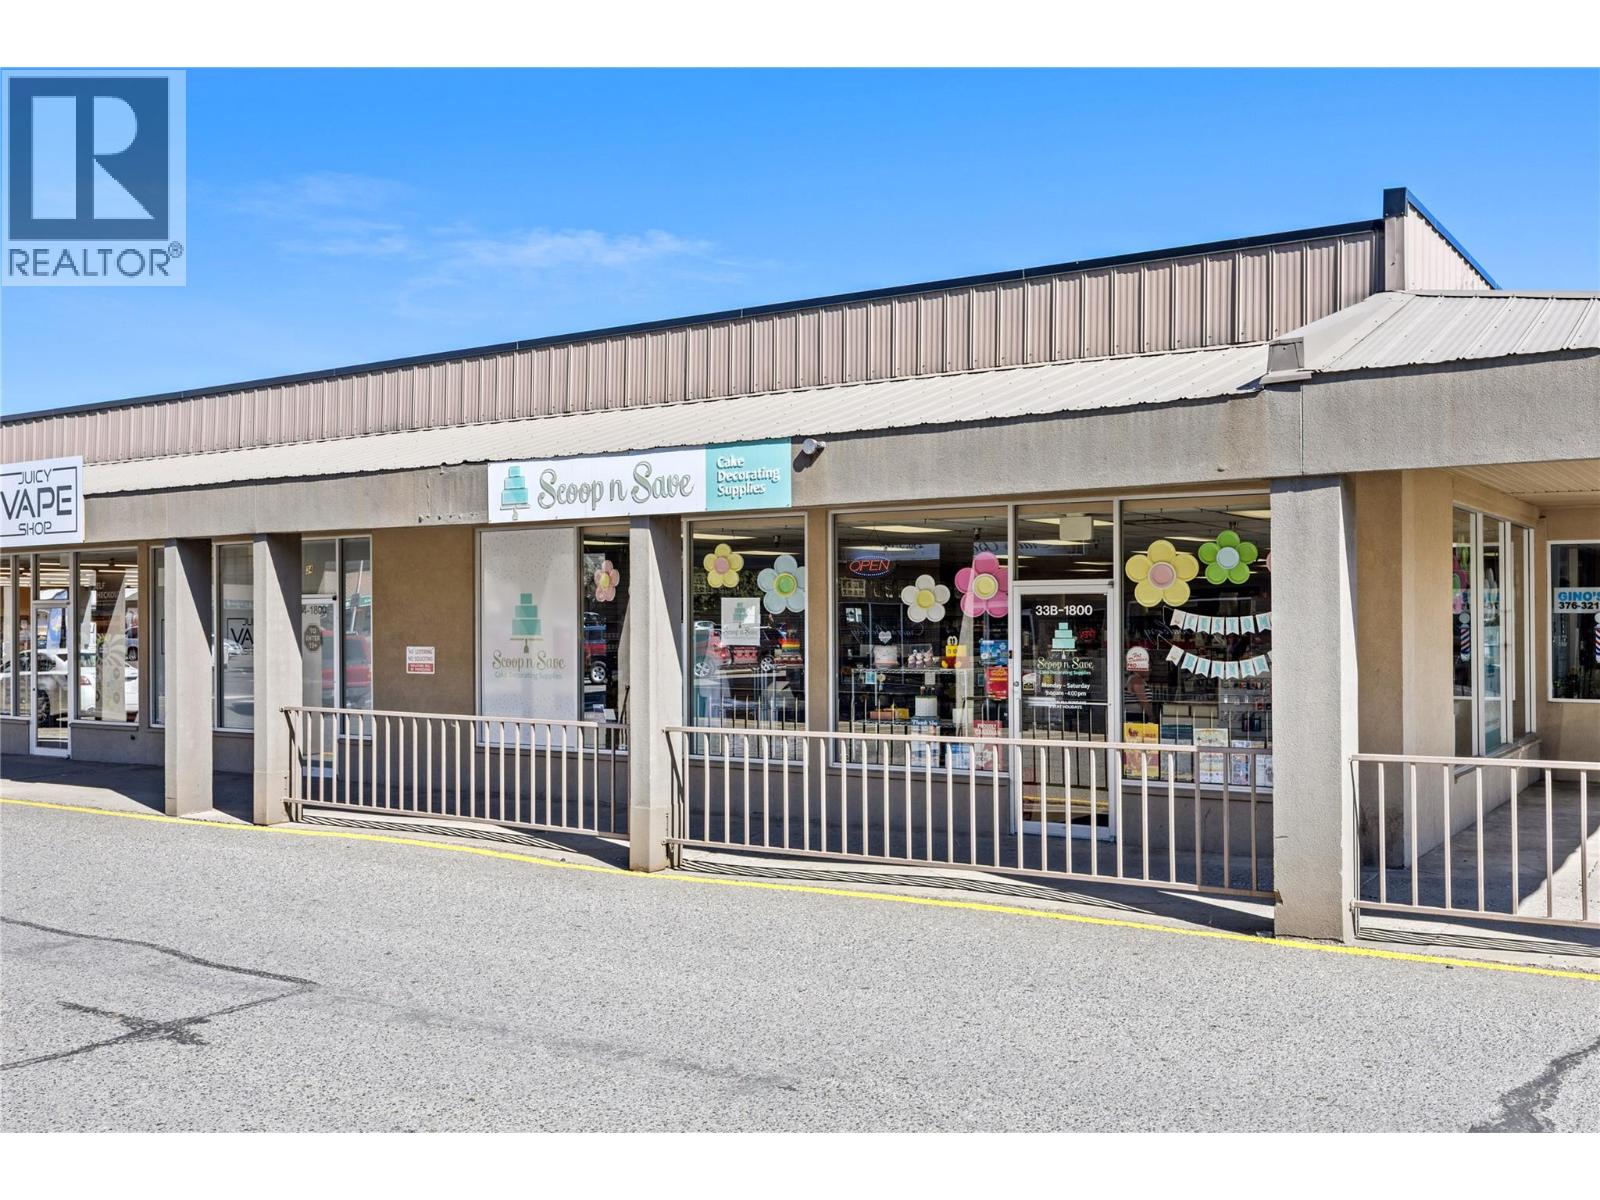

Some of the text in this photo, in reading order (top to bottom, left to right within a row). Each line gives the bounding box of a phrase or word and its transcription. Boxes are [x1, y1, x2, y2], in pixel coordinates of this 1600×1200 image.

[716, 455, 745, 470] Cake
[18, 468, 52, 485] JUICY
[717, 467, 780, 484] Decorating
[537, 460, 694, 511] Scoop n Save
[717, 482, 767, 500] Supplies
[0, 485, 73, 520] VAPE
[18, 521, 52, 536] SHOP
[849, 559, 890, 572] OPEN
[1035, 605, 1093, 616] 33B-1800
[230, 628, 253, 645] VA
[492, 649, 524, 672] Scoop
[536, 650, 566, 671] Save
[1037, 657, 1062, 671] Scoop
[1072, 656, 1095, 670] Save
